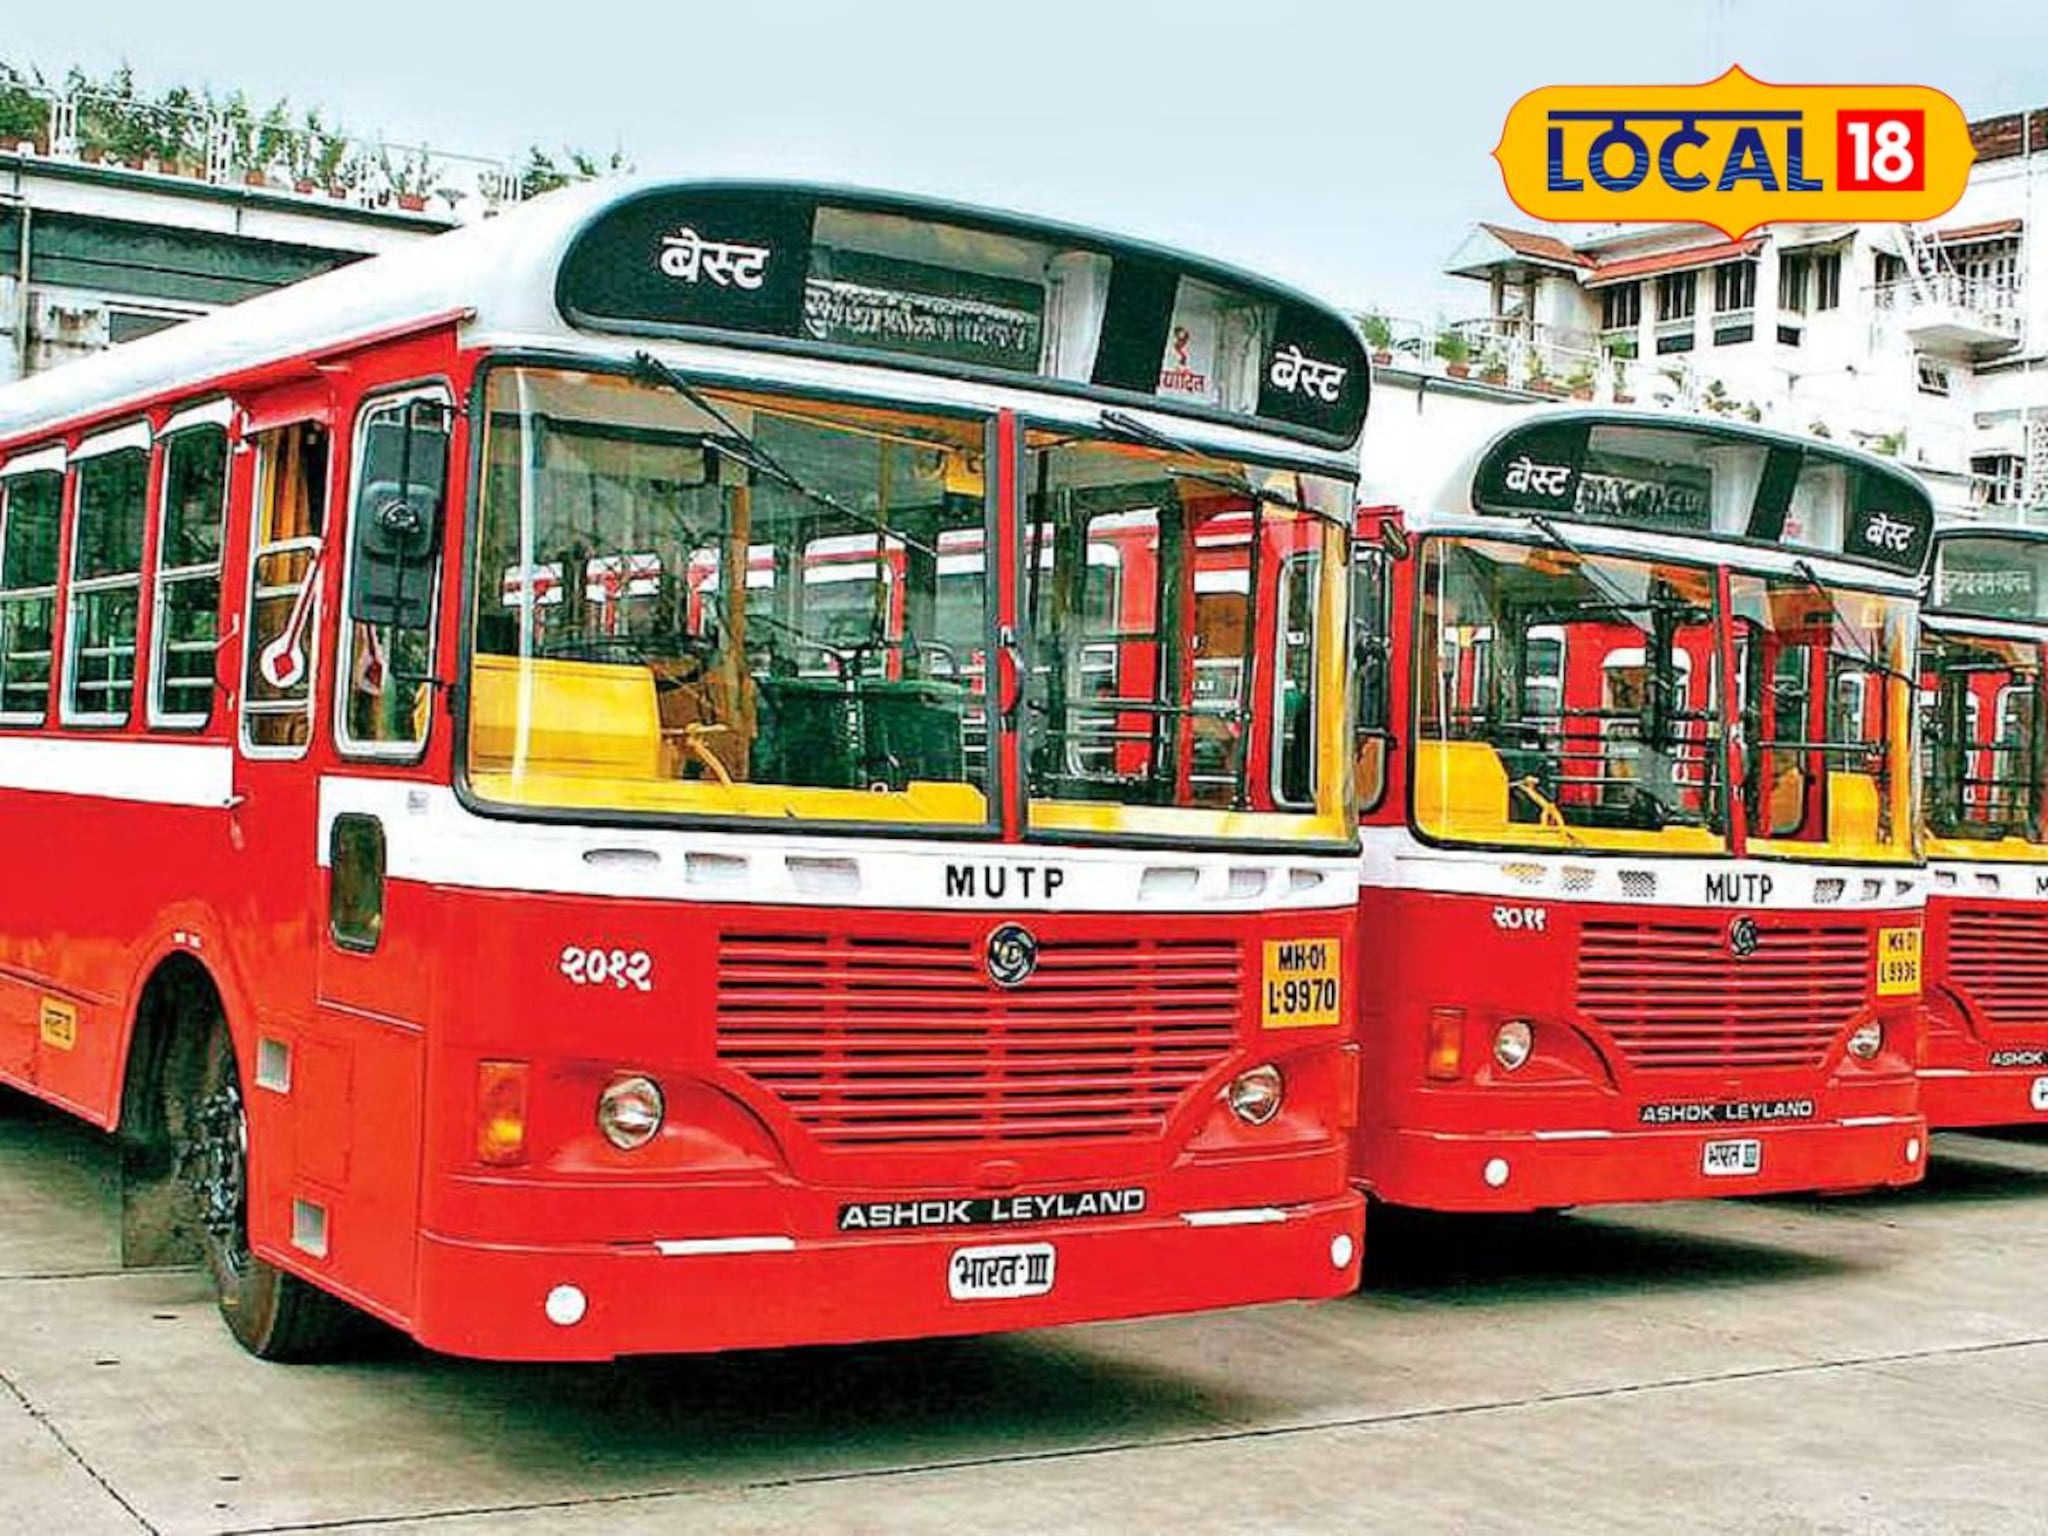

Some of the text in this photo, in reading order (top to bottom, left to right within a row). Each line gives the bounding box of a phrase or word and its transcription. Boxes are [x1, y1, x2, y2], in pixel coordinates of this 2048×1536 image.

[660, 228, 770, 290] बेस्ट
[1270, 346, 1348, 402] बेस्ट
[1505, 457, 1571, 496] बेस्ट
[1865, 513, 1914, 551] बेस्ट
[946, 865, 1064, 899] MUTP
[1705, 873, 1773, 904] MUTP
[1642, 1100, 1813, 1122] ASHOK LEYLAND
[841, 1189, 1145, 1229] ASHOK LEYLAND
